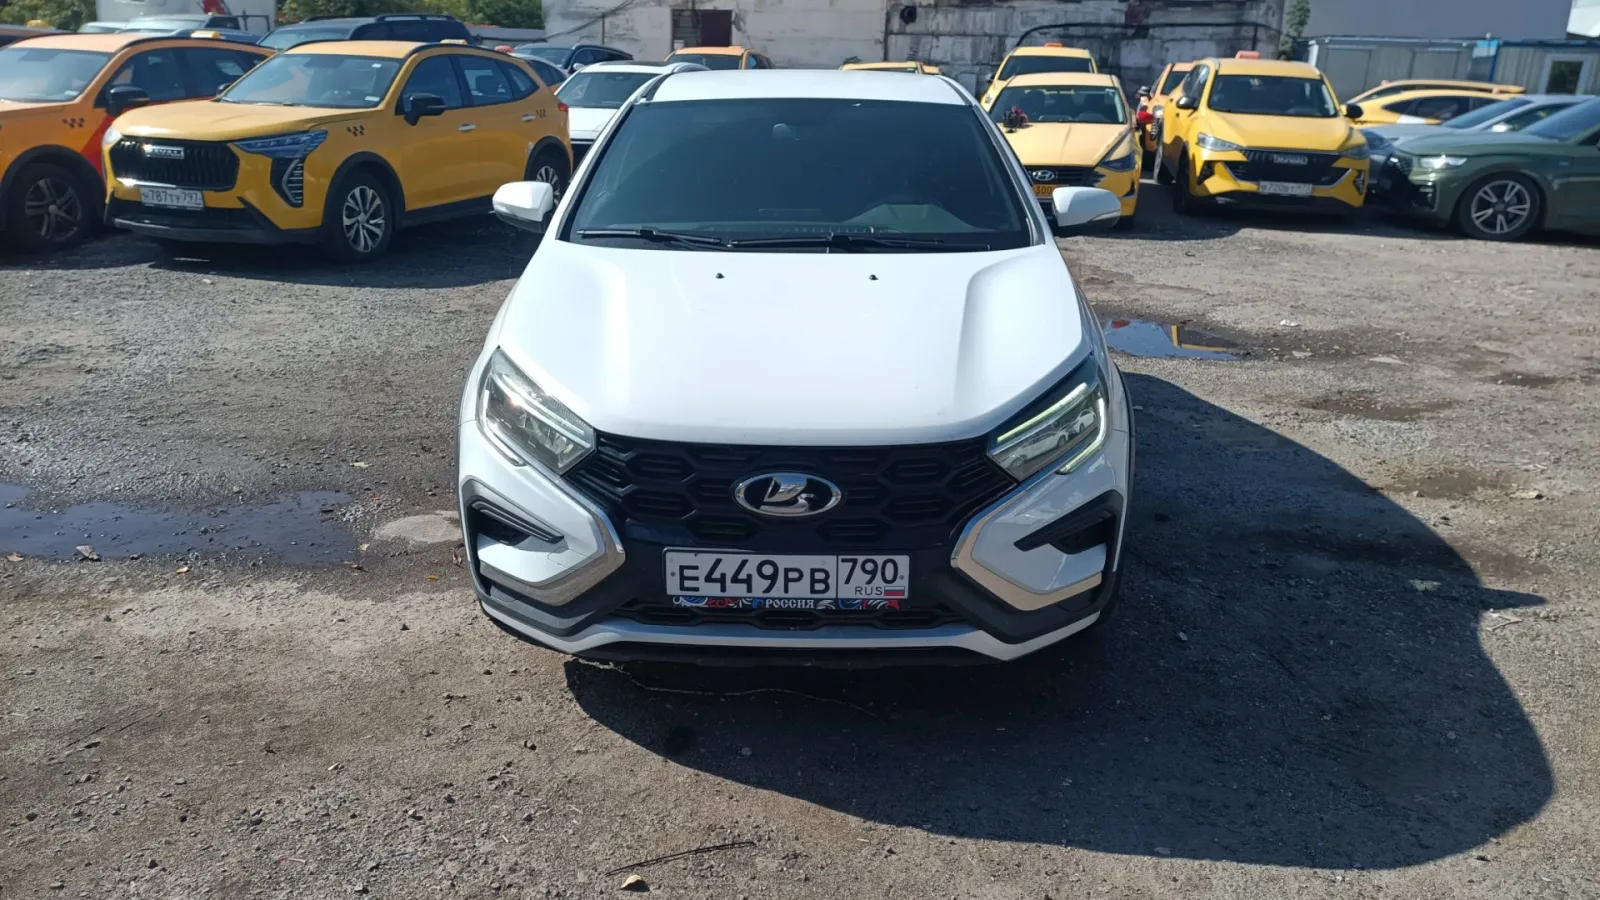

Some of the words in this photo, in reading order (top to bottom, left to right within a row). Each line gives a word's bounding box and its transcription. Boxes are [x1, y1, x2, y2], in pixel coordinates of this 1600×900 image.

[840, 557, 899, 585] 790
[854, 586, 883, 596] RUS
[765, 598, 815, 609] РОССИЯ
